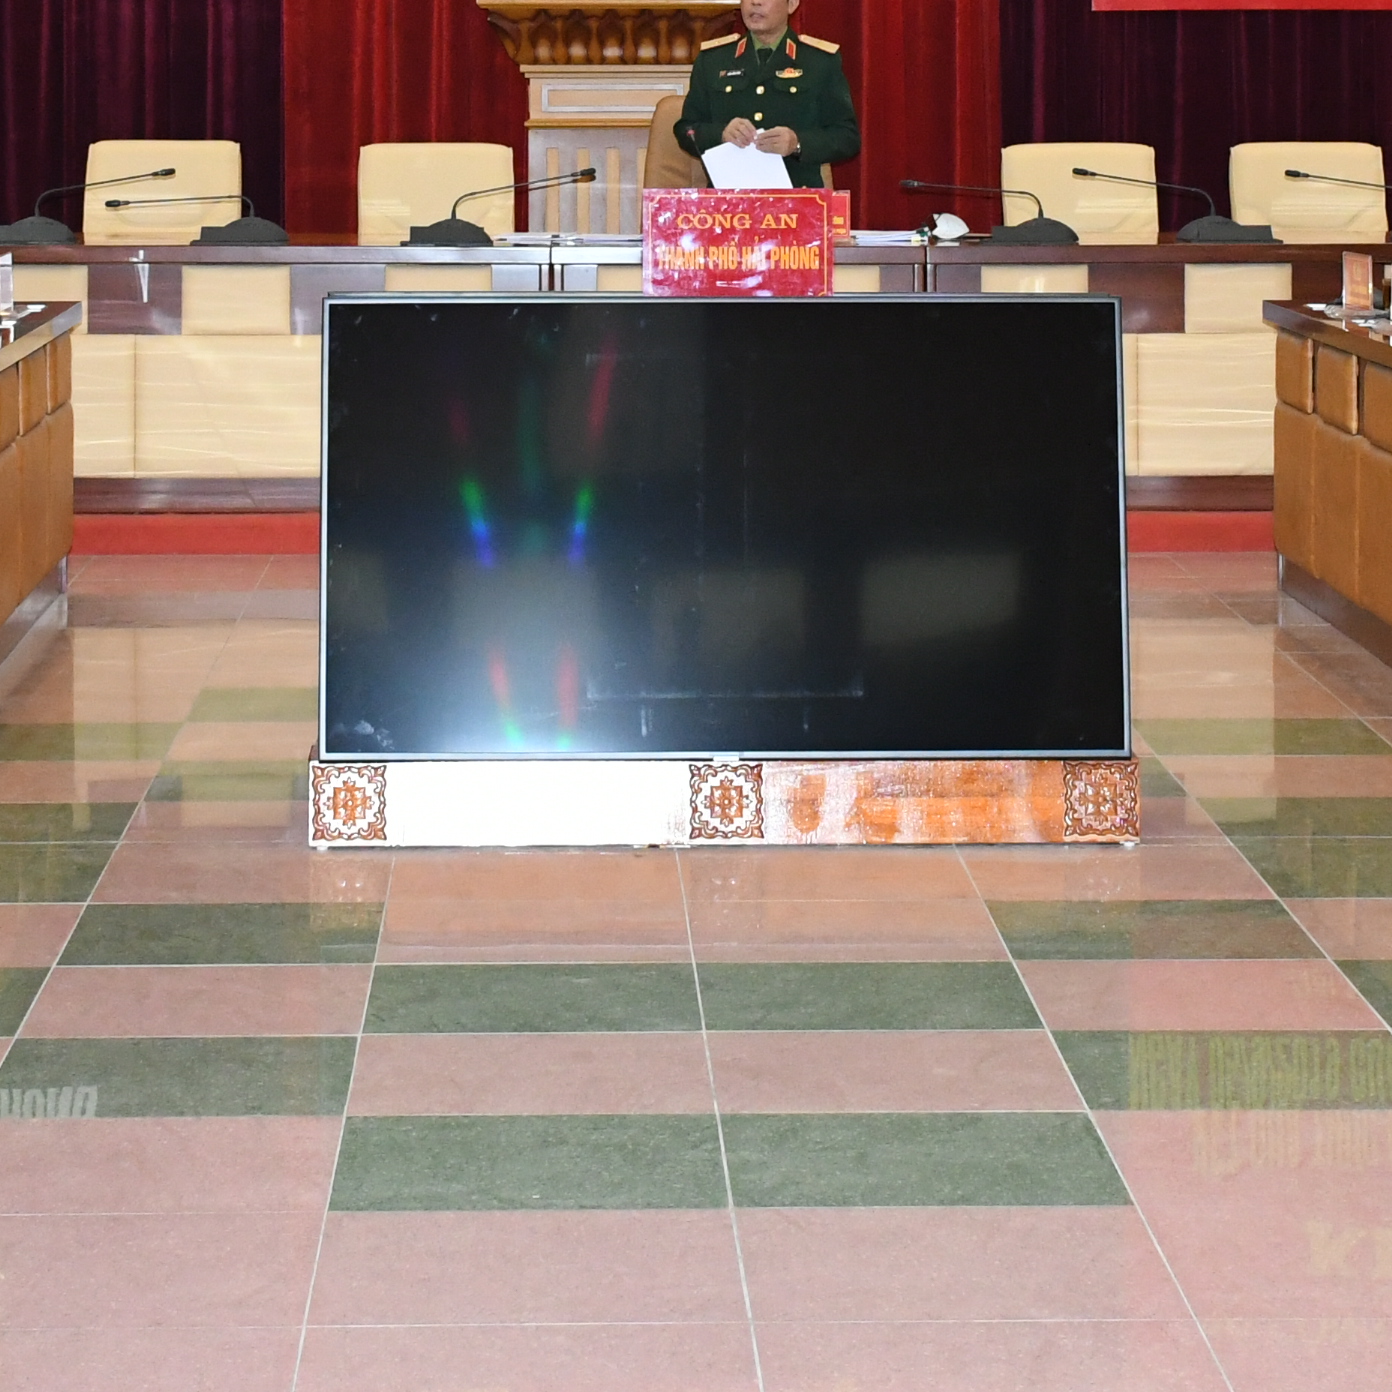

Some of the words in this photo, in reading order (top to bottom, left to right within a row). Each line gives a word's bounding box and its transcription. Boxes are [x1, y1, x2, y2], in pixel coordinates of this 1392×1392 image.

[677, 209, 751, 229] CÔNG
[760, 214, 798, 228] AN
[771, 241, 820, 270] PHÒNG
